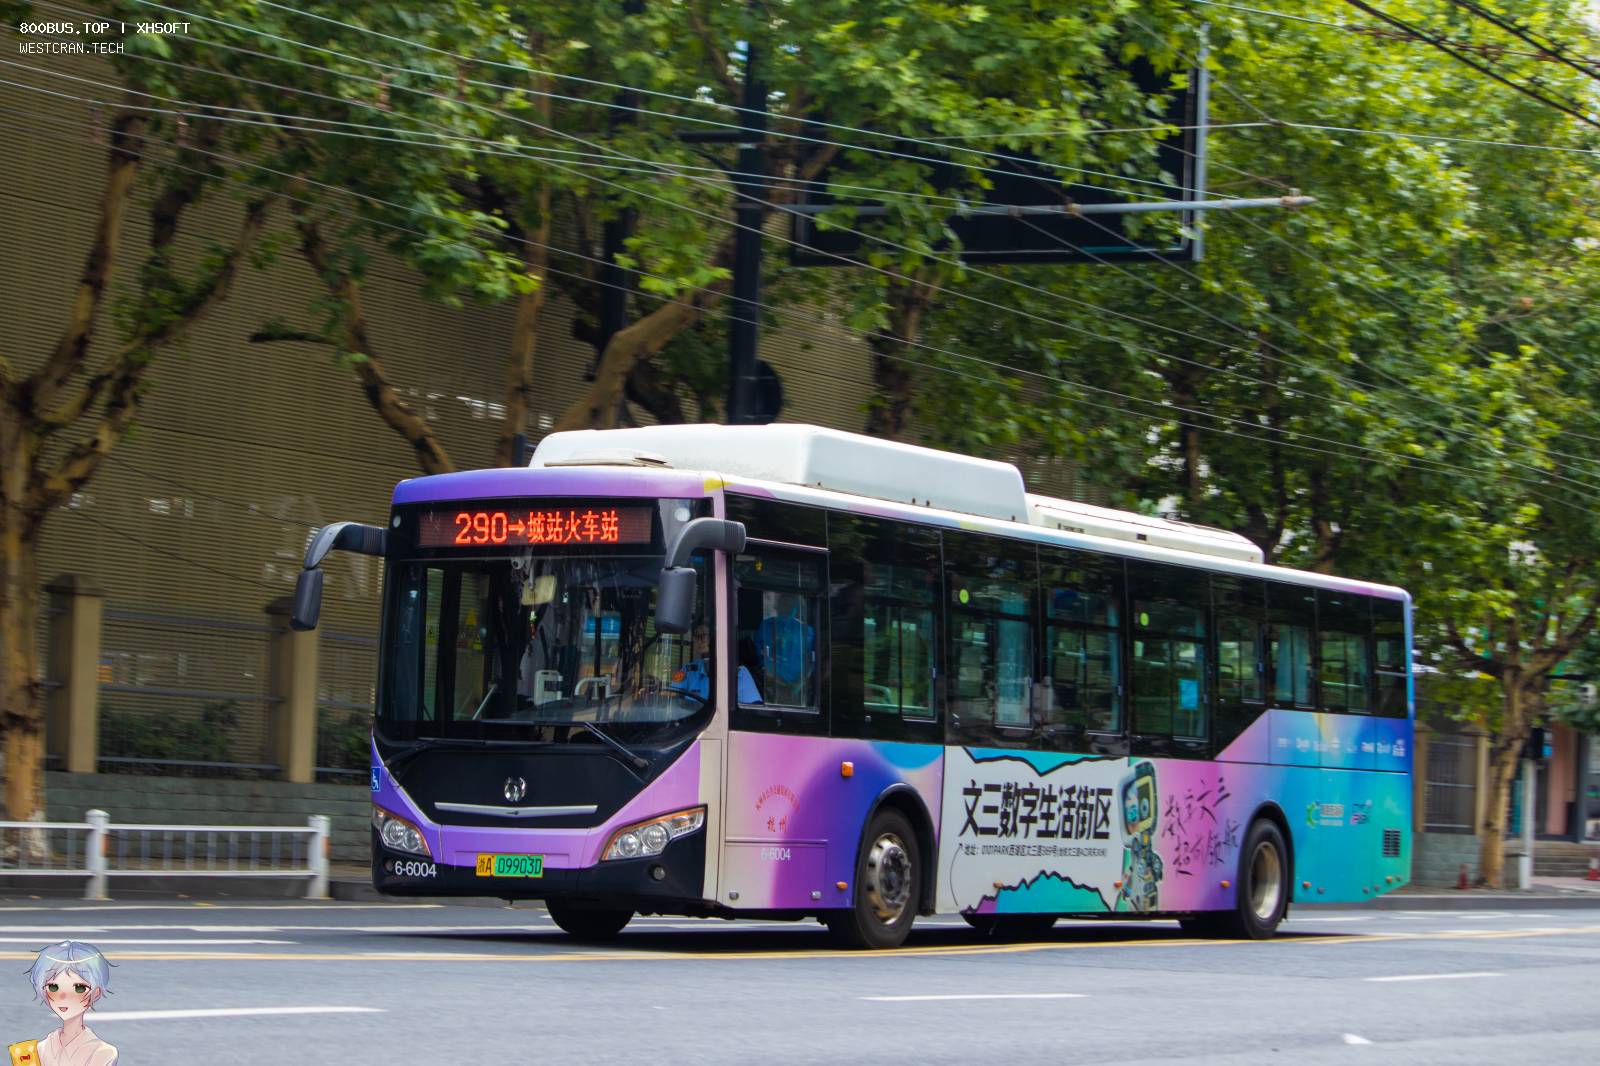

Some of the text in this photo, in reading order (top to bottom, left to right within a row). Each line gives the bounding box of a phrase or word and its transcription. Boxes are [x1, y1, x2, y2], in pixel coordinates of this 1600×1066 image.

[455, 510, 619, 544] 290 城站火车站
[958, 779, 1113, 840] 文三数字生活街区
[394, 860, 437, 878] 6-6004
